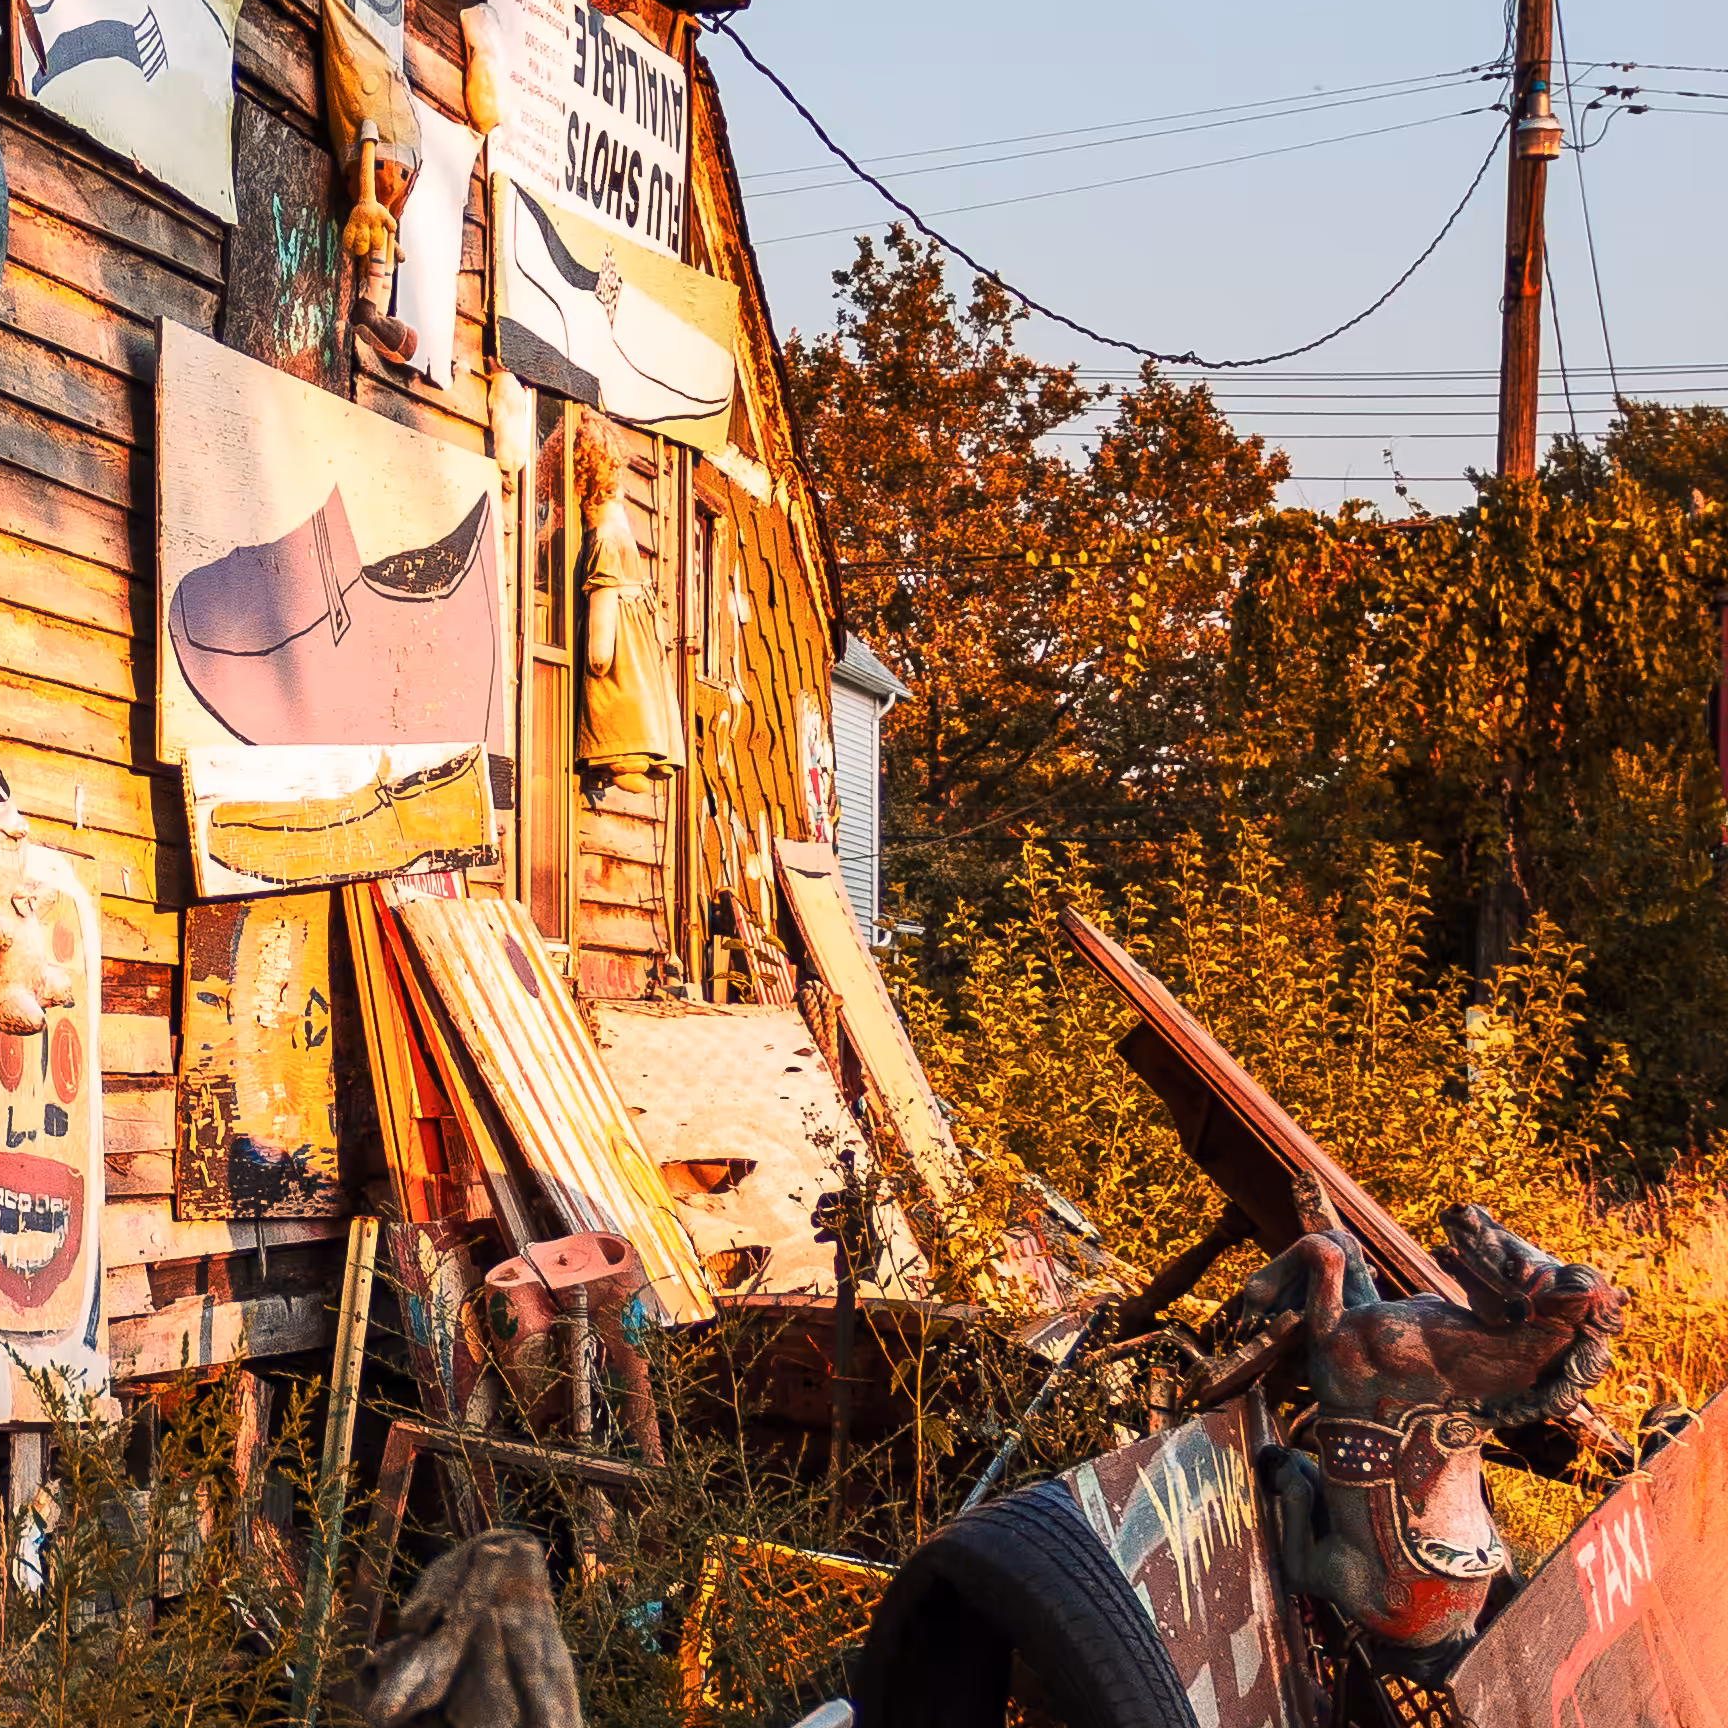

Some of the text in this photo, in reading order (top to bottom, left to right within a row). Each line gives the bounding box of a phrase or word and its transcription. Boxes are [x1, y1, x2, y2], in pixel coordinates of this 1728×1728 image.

[573, 4, 684, 154] AVAILABLE
[565, 110, 643, 228] SHOTS
[646, 162, 683, 255] FLU
